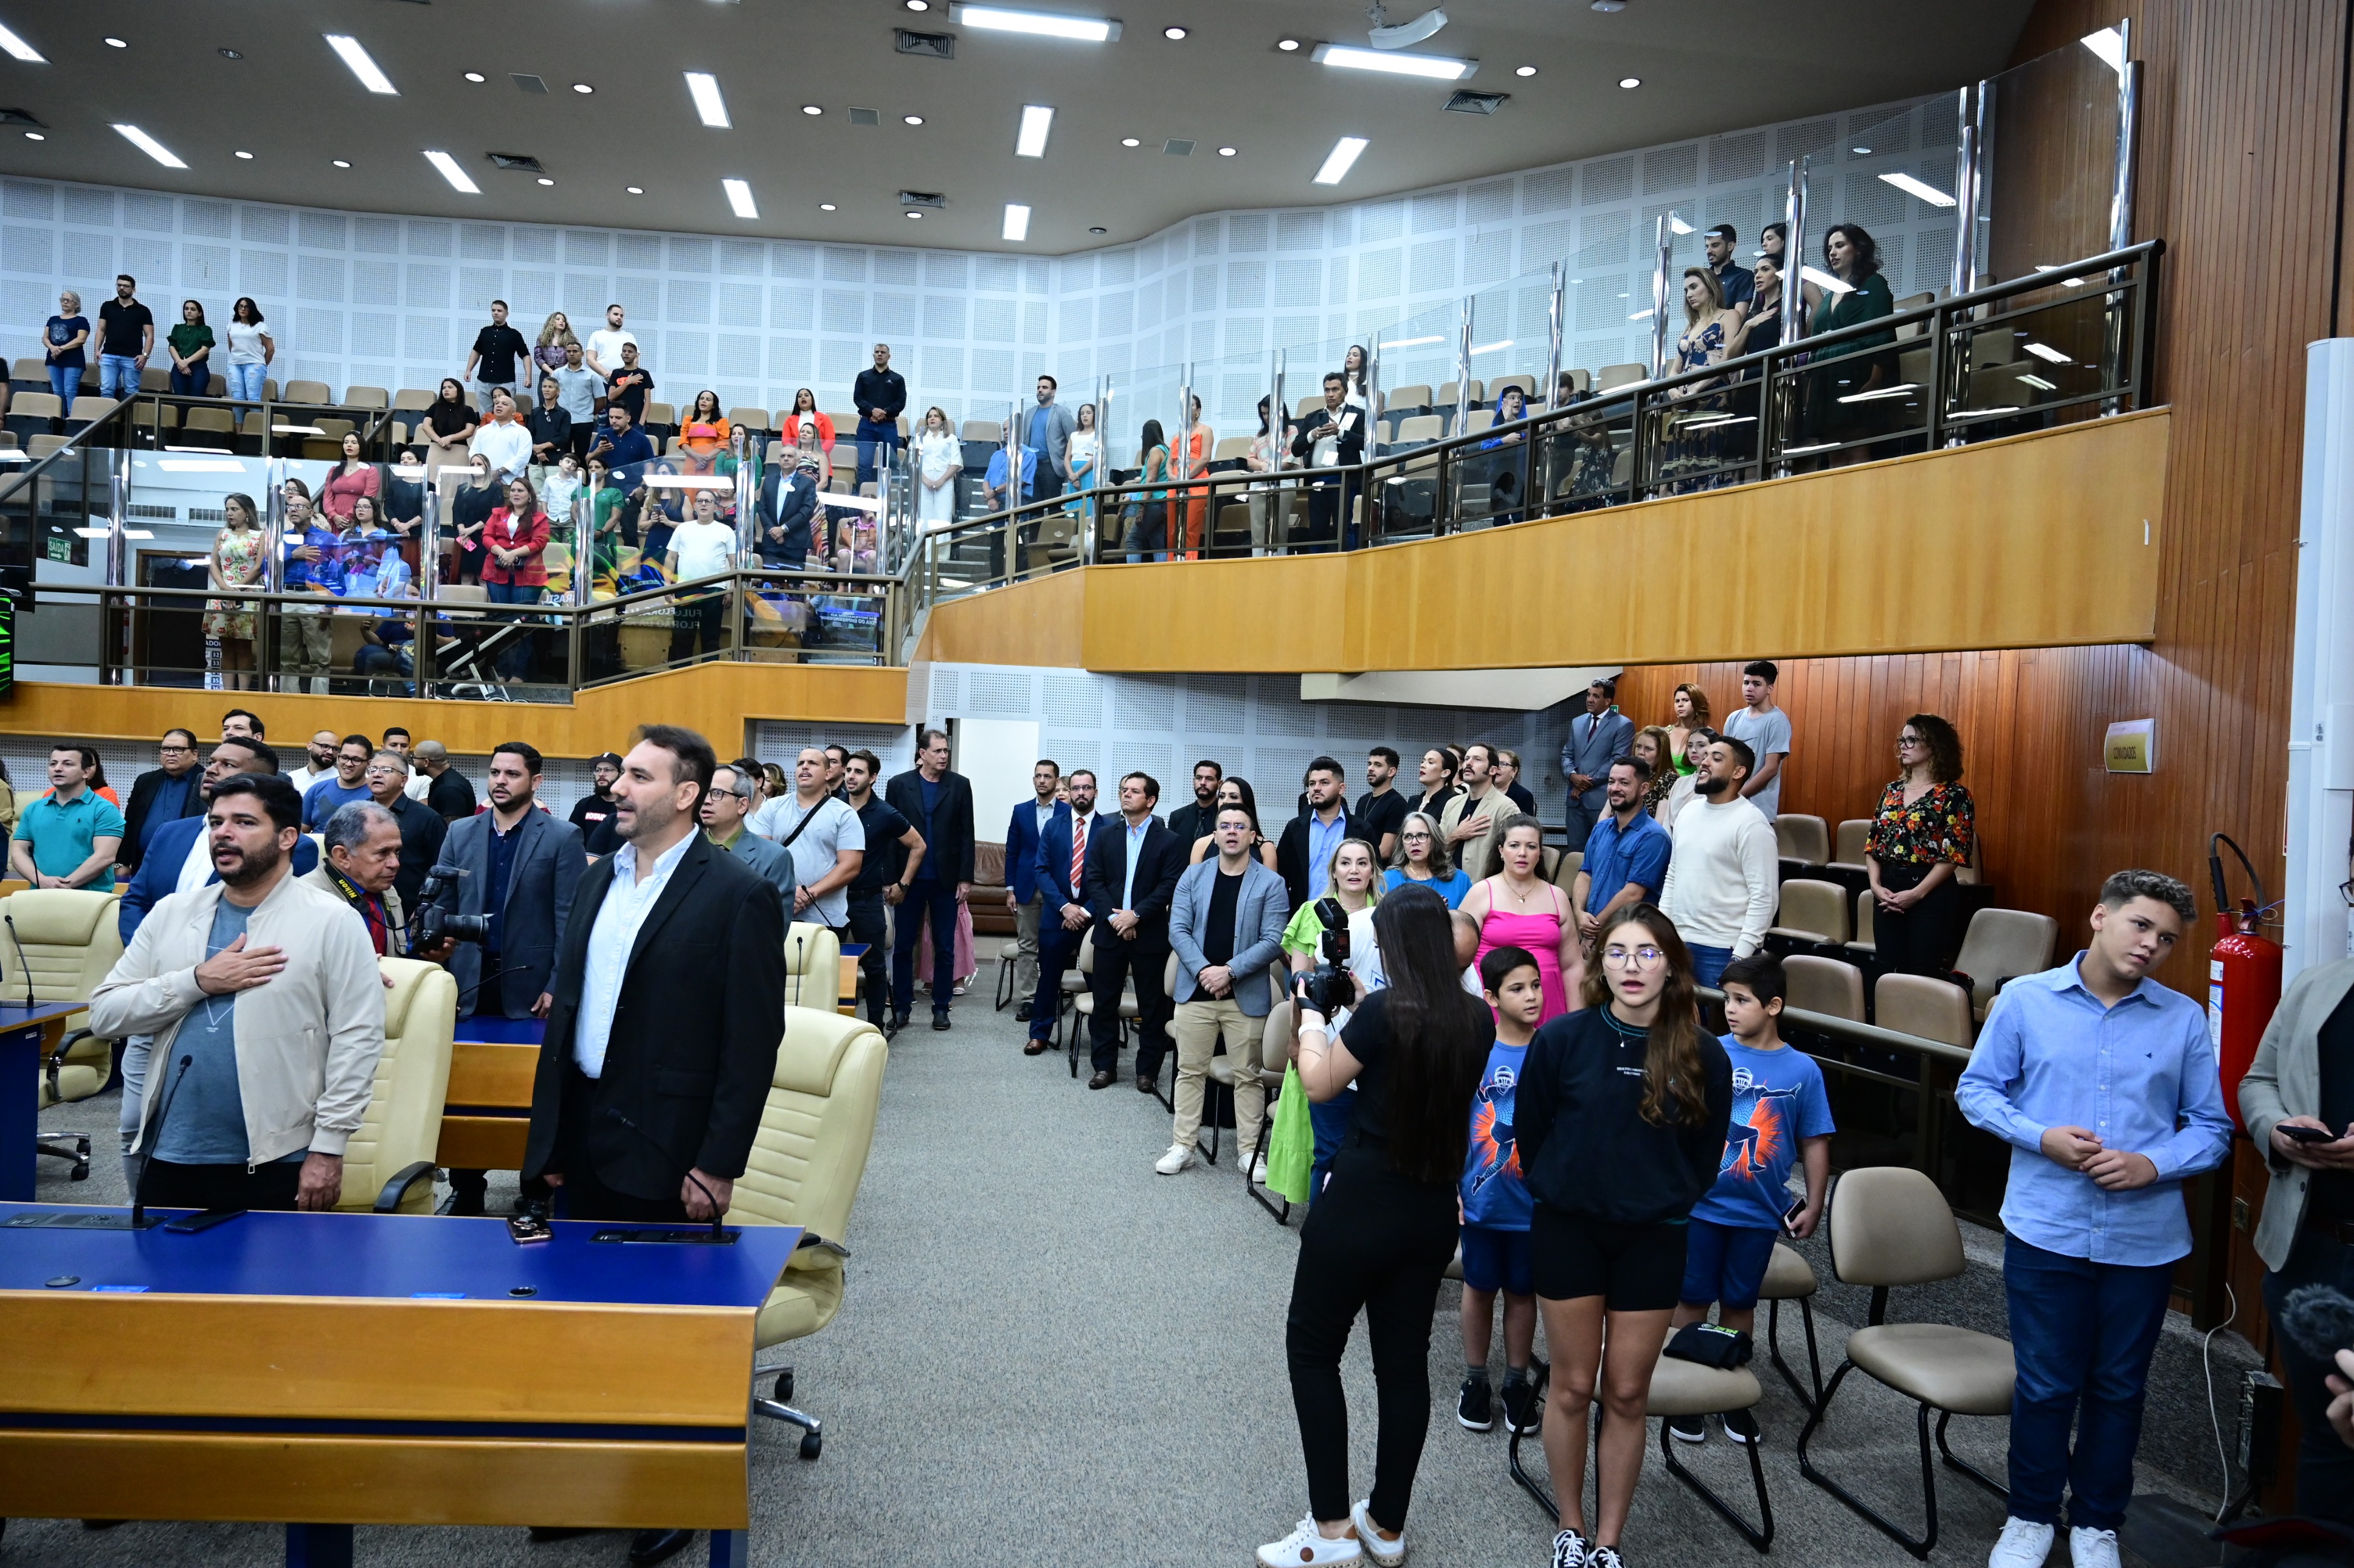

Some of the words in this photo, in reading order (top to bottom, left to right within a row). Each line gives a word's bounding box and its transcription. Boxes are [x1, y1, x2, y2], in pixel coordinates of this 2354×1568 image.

[49, 540, 64, 553] SAÍDA
[2113, 745, 2136, 760] CONVIDADOS
[338, 879, 357, 898] Nikon
